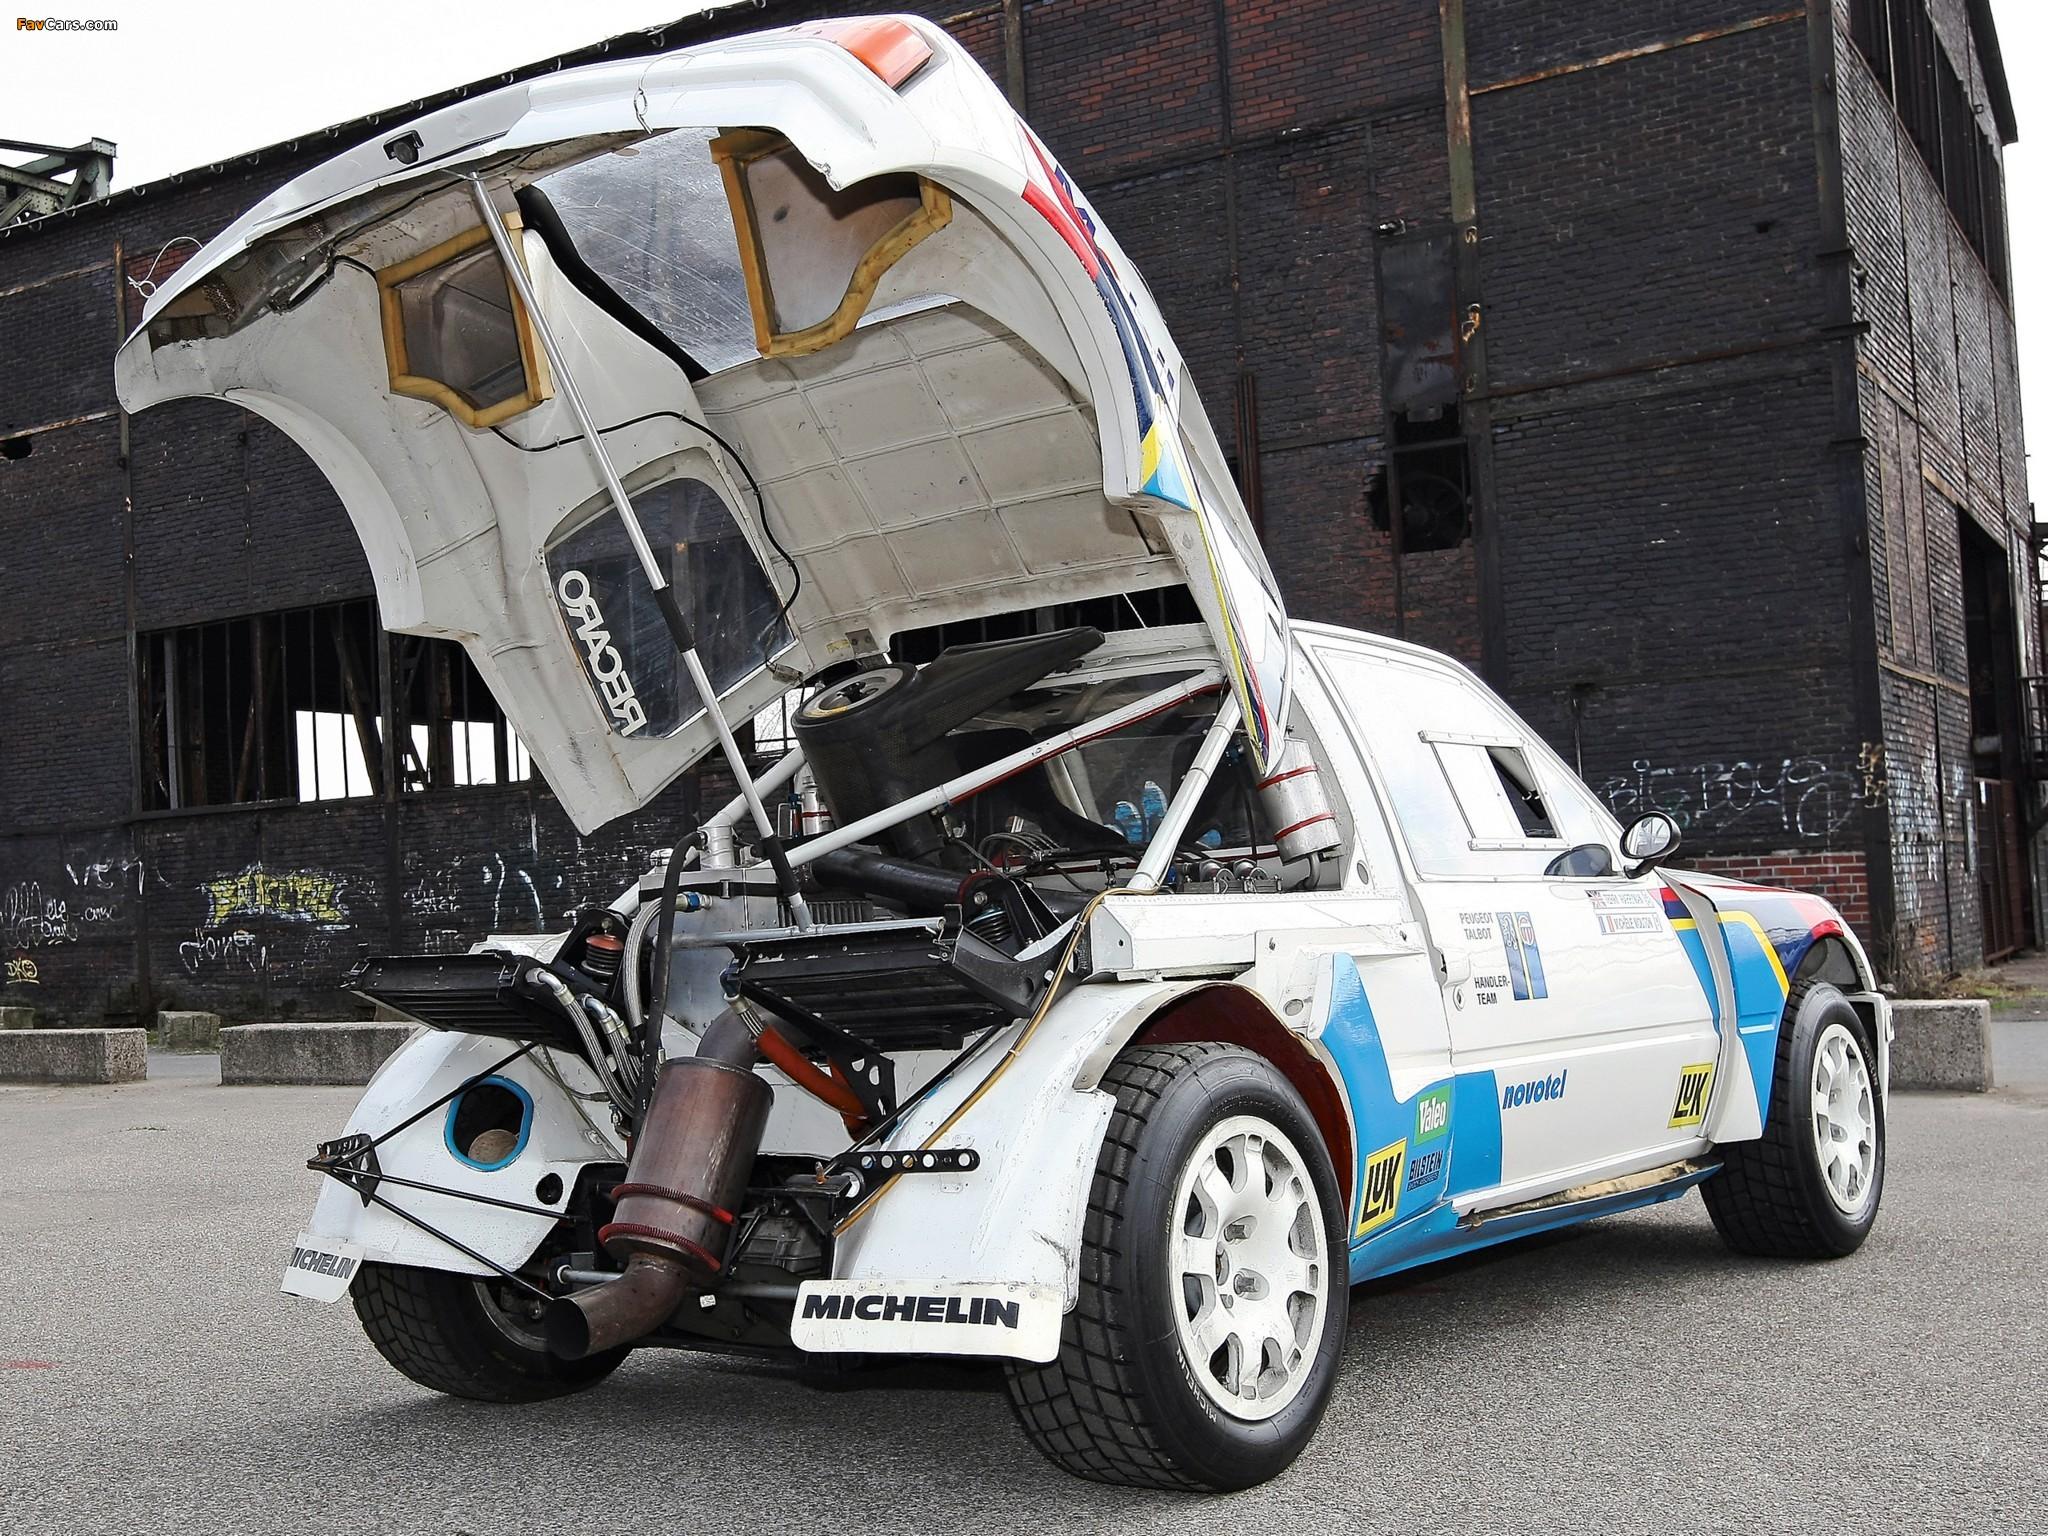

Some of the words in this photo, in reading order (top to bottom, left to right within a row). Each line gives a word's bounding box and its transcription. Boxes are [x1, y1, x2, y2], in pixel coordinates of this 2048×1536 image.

[1459, 912, 1494, 925] PEUGEOT
[1464, 928, 1492, 940] TALBOT
[1477, 992, 1498, 1005] TEAM
[1502, 1069, 1568, 1110] novotel
[1418, 1096, 1447, 1135] Valeo
[802, 1294, 1020, 1329] MICHELIN
